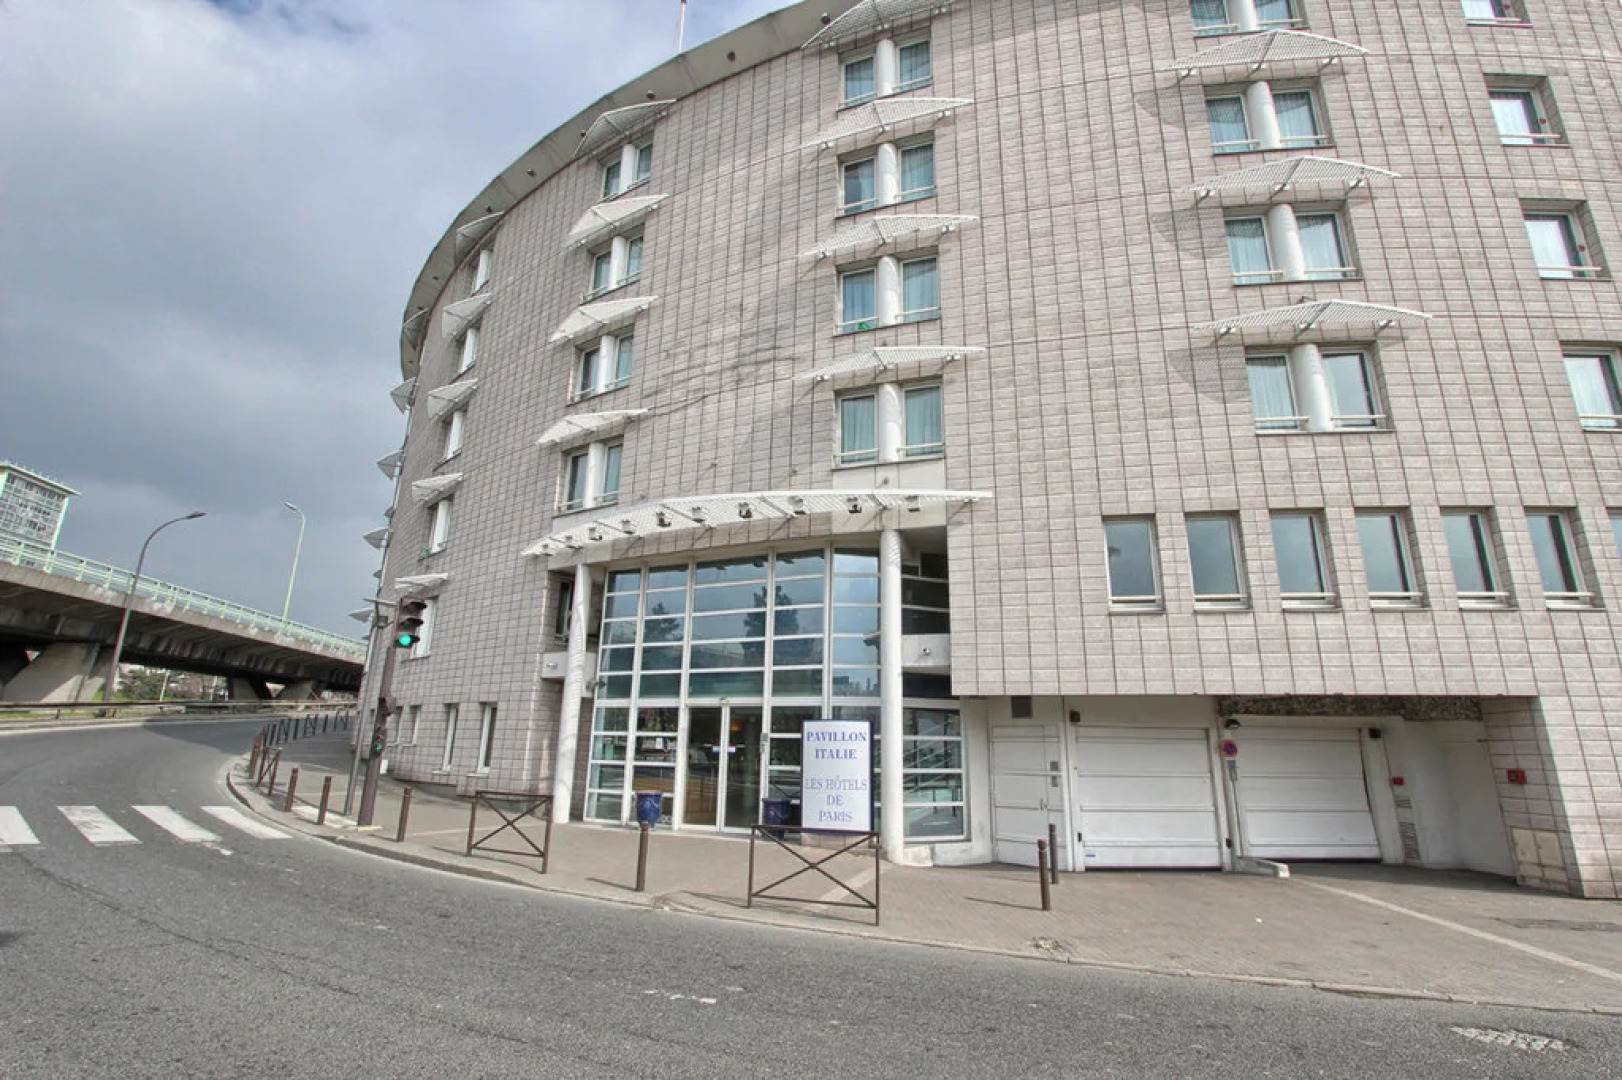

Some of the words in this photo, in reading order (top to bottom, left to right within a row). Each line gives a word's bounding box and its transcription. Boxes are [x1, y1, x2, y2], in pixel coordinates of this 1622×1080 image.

[806, 731, 867, 742] PAVILLON
[814, 748, 857, 760] ITALIE
[805, 778, 823, 790] LES
[826, 776, 867, 791] HÔTELS
[826, 794, 844, 806] DE
[818, 810, 853, 823] PARIS
